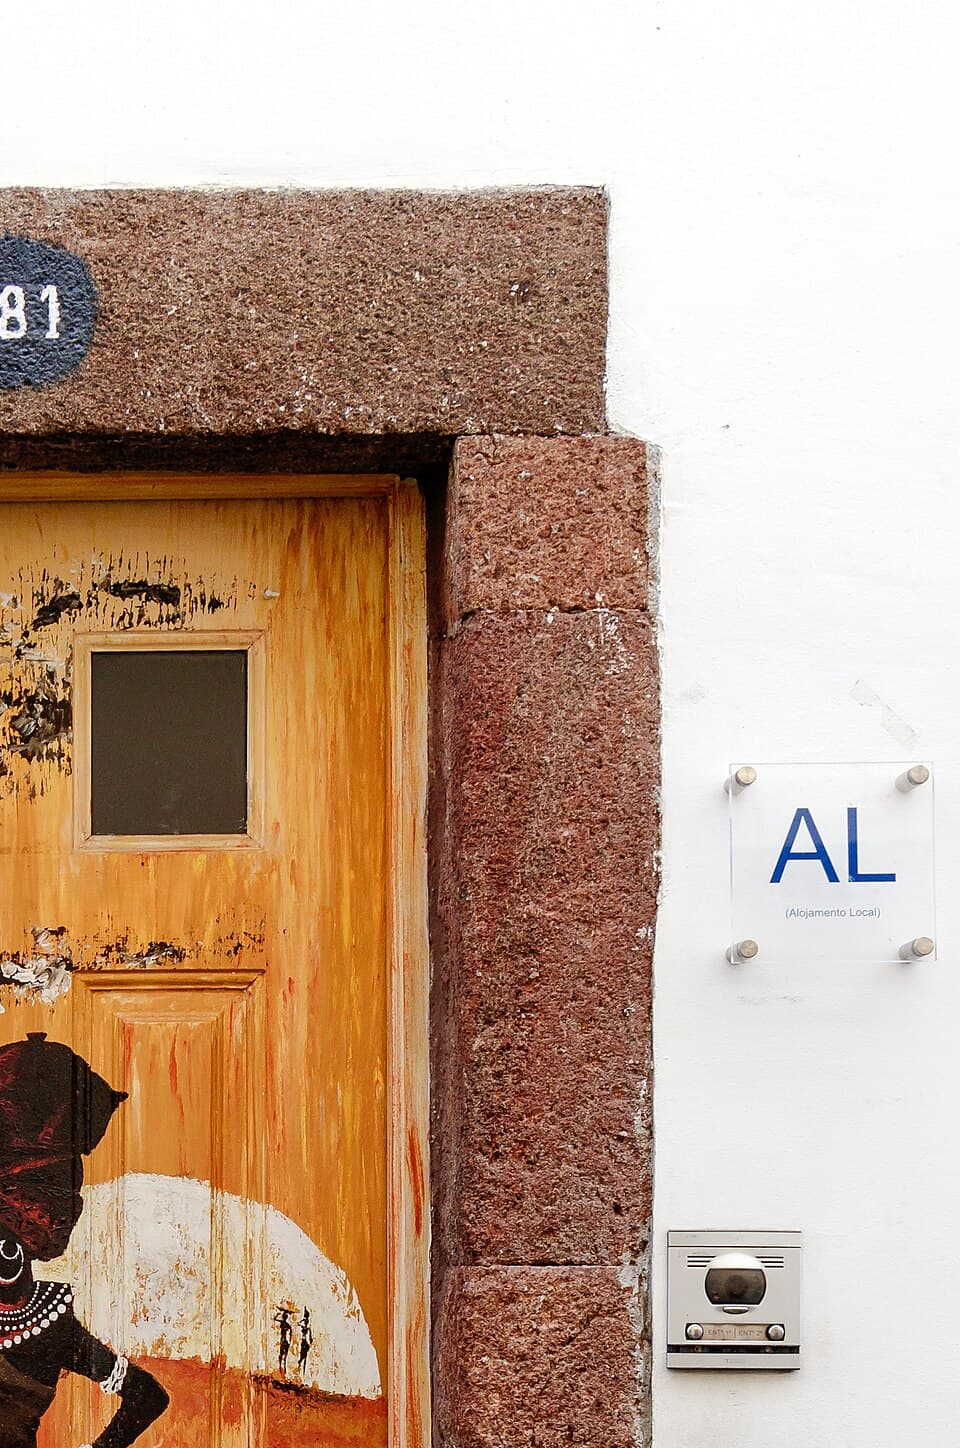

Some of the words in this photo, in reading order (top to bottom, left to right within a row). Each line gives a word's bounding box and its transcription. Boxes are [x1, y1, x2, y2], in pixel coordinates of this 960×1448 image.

[769, 807, 896, 883] AL
[785, 906, 846, 920] (Alojamento
[849, 906, 881, 919] Local)
